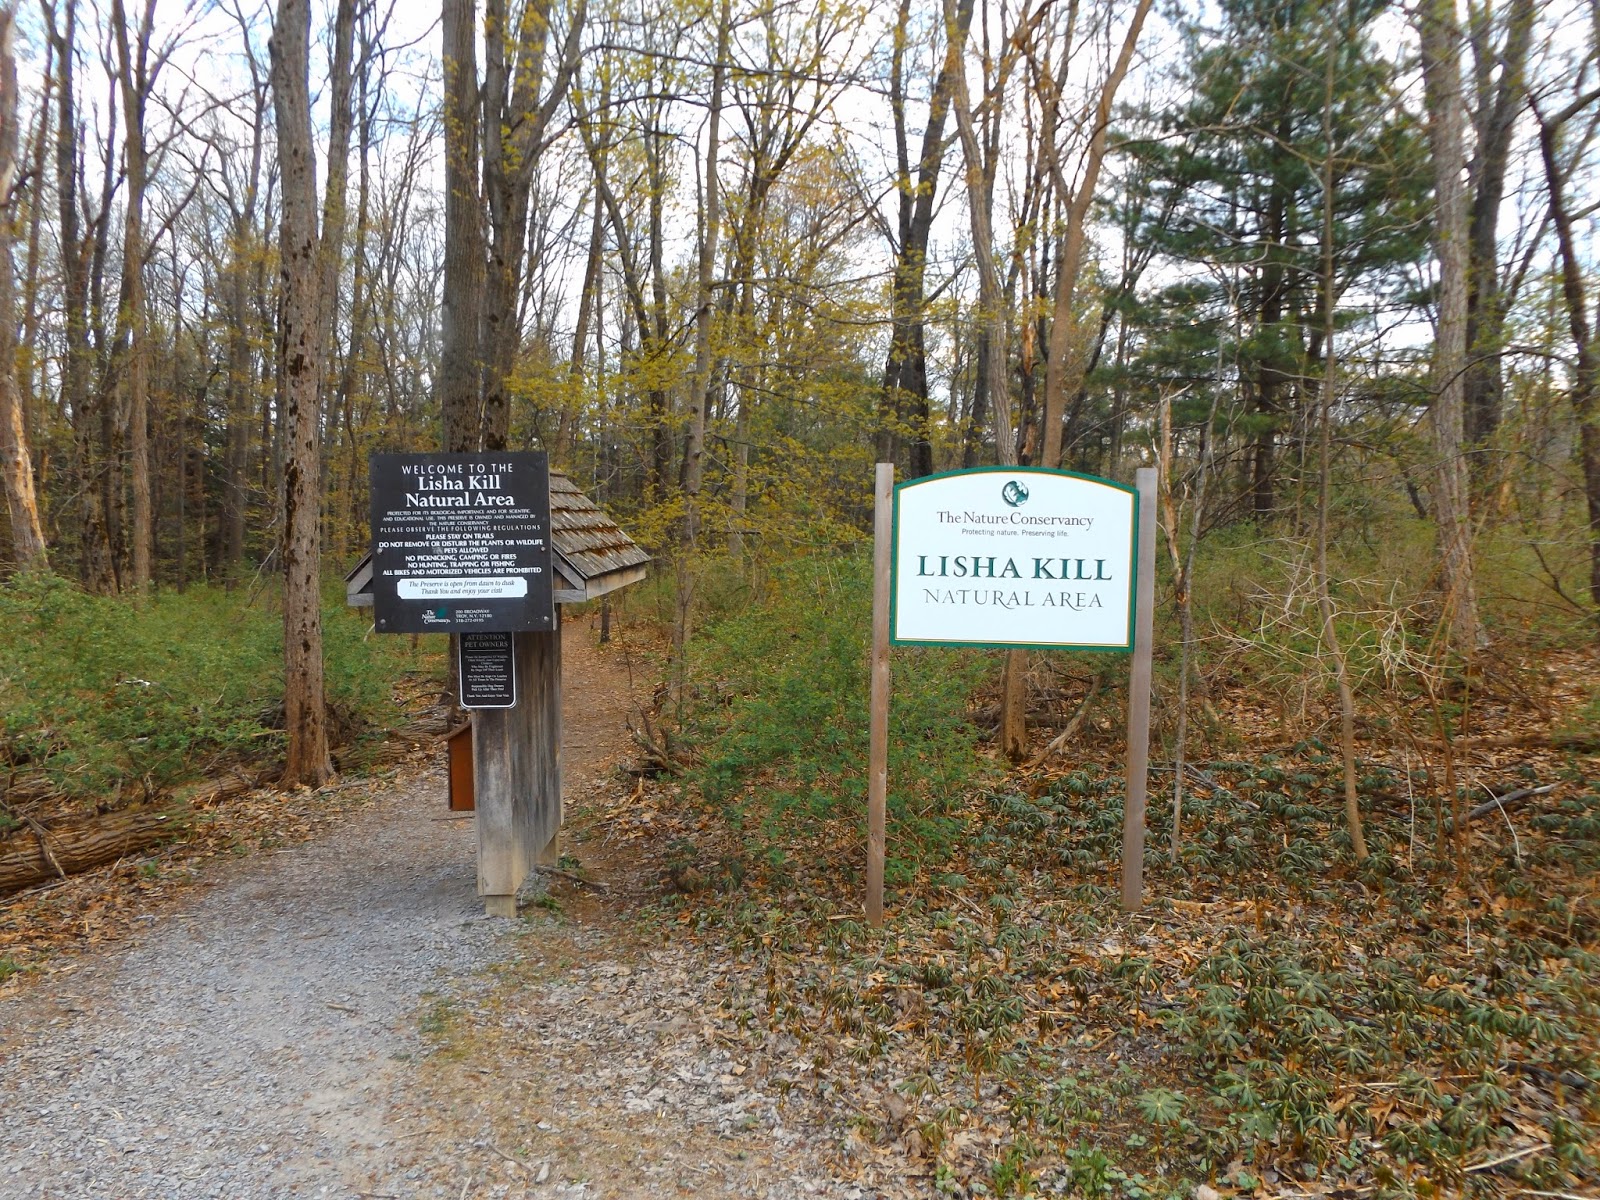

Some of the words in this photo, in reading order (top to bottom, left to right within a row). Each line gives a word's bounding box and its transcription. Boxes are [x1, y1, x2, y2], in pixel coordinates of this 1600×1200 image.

[402, 464, 462, 475] WELCOME
[469, 464, 485, 473] TO
[491, 463, 513, 473] THE
[418, 476, 463, 491] Lisha
[469, 475, 500, 490] Kill
[406, 492, 470, 507] Natural
[474, 493, 515, 506] Area
[937, 512, 961, 524] The
[964, 512, 1008, 524] Nature
[1010, 512, 1094, 531] Conservancy
[917, 555, 1022, 579] LISHA
[1031, 558, 1112, 581] KILL
[923, 588, 1034, 610] NATURAL
[1042, 592, 1103, 611] AREA
